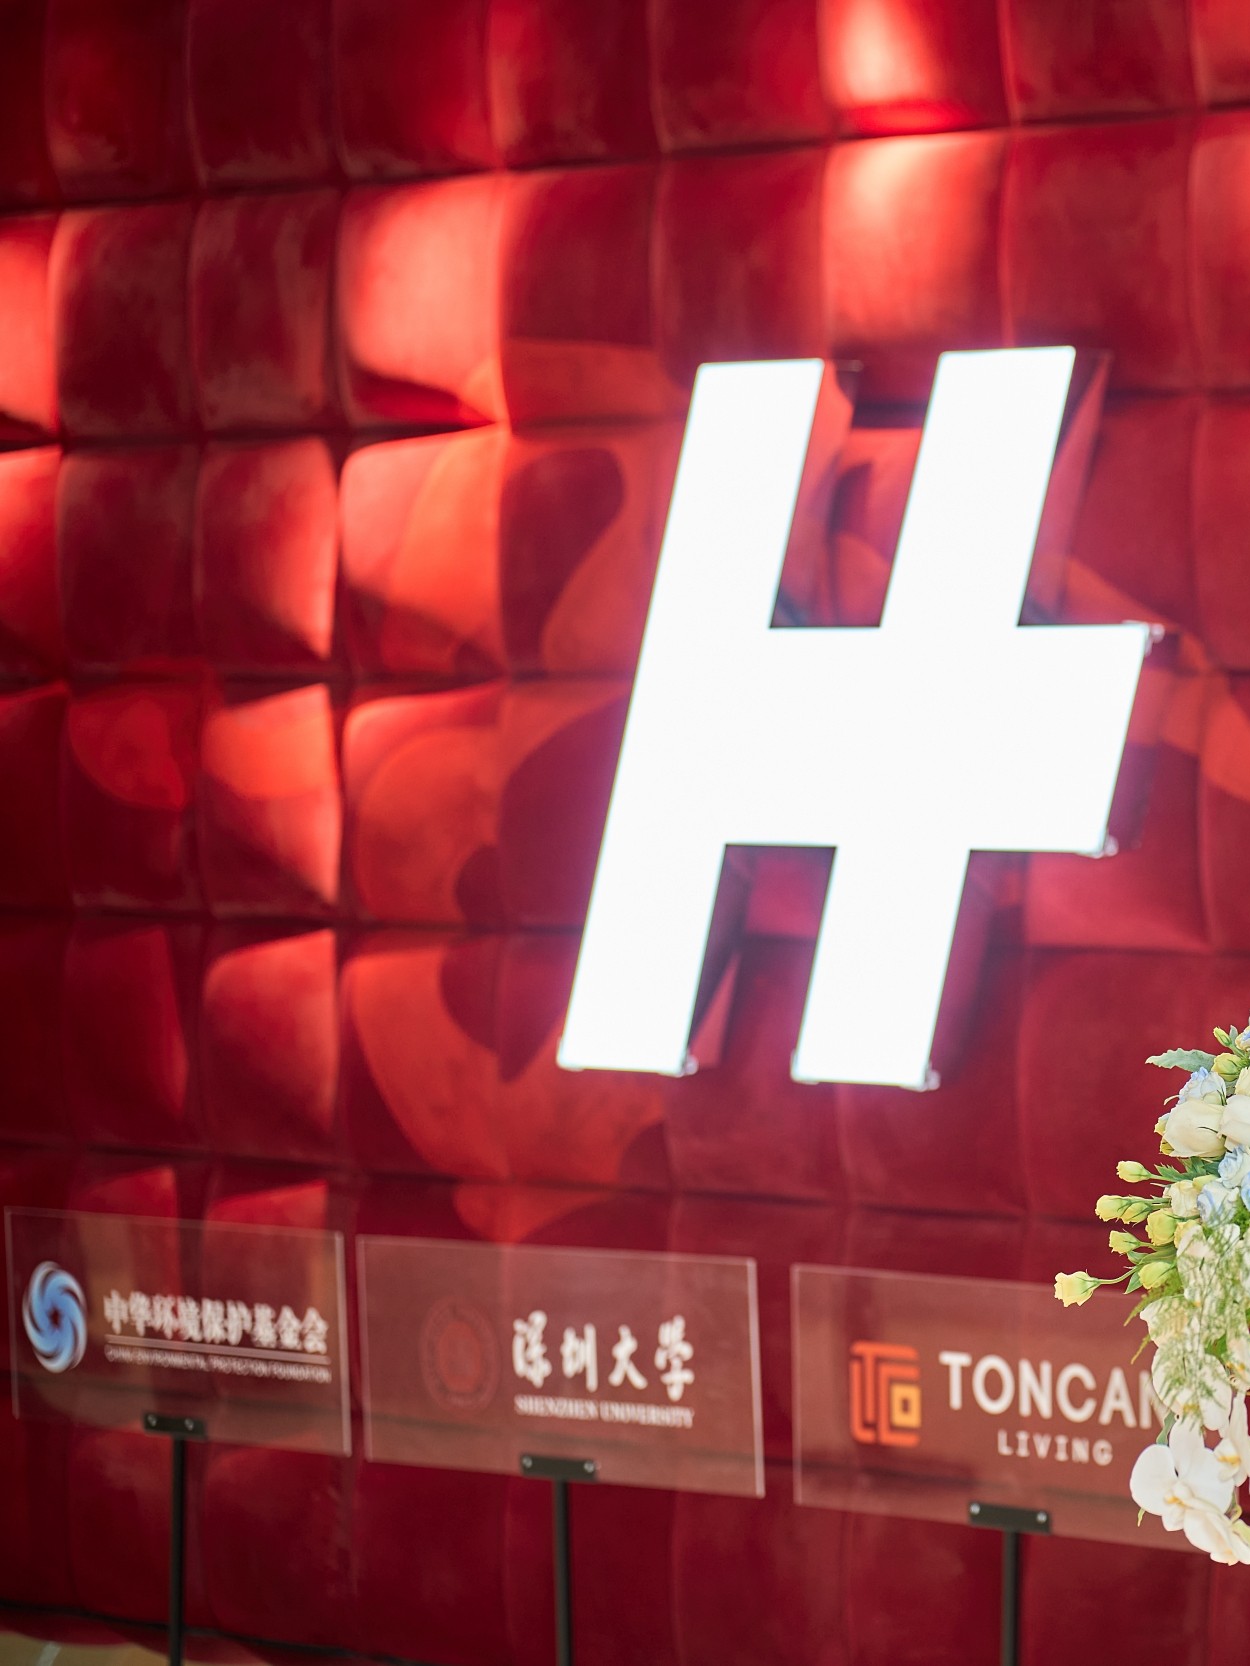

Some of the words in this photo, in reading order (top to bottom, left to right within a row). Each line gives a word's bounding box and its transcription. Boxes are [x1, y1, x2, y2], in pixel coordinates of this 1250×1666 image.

[103, 1289, 328, 1354] 中华环境保护基金会
[512, 1309, 695, 1401] 深圳大学
[514, 1395, 598, 1420] SHENZHEN
[600, 1400, 695, 1428] UNIVERSITY
[998, 1429, 1113, 1466] LIVING
